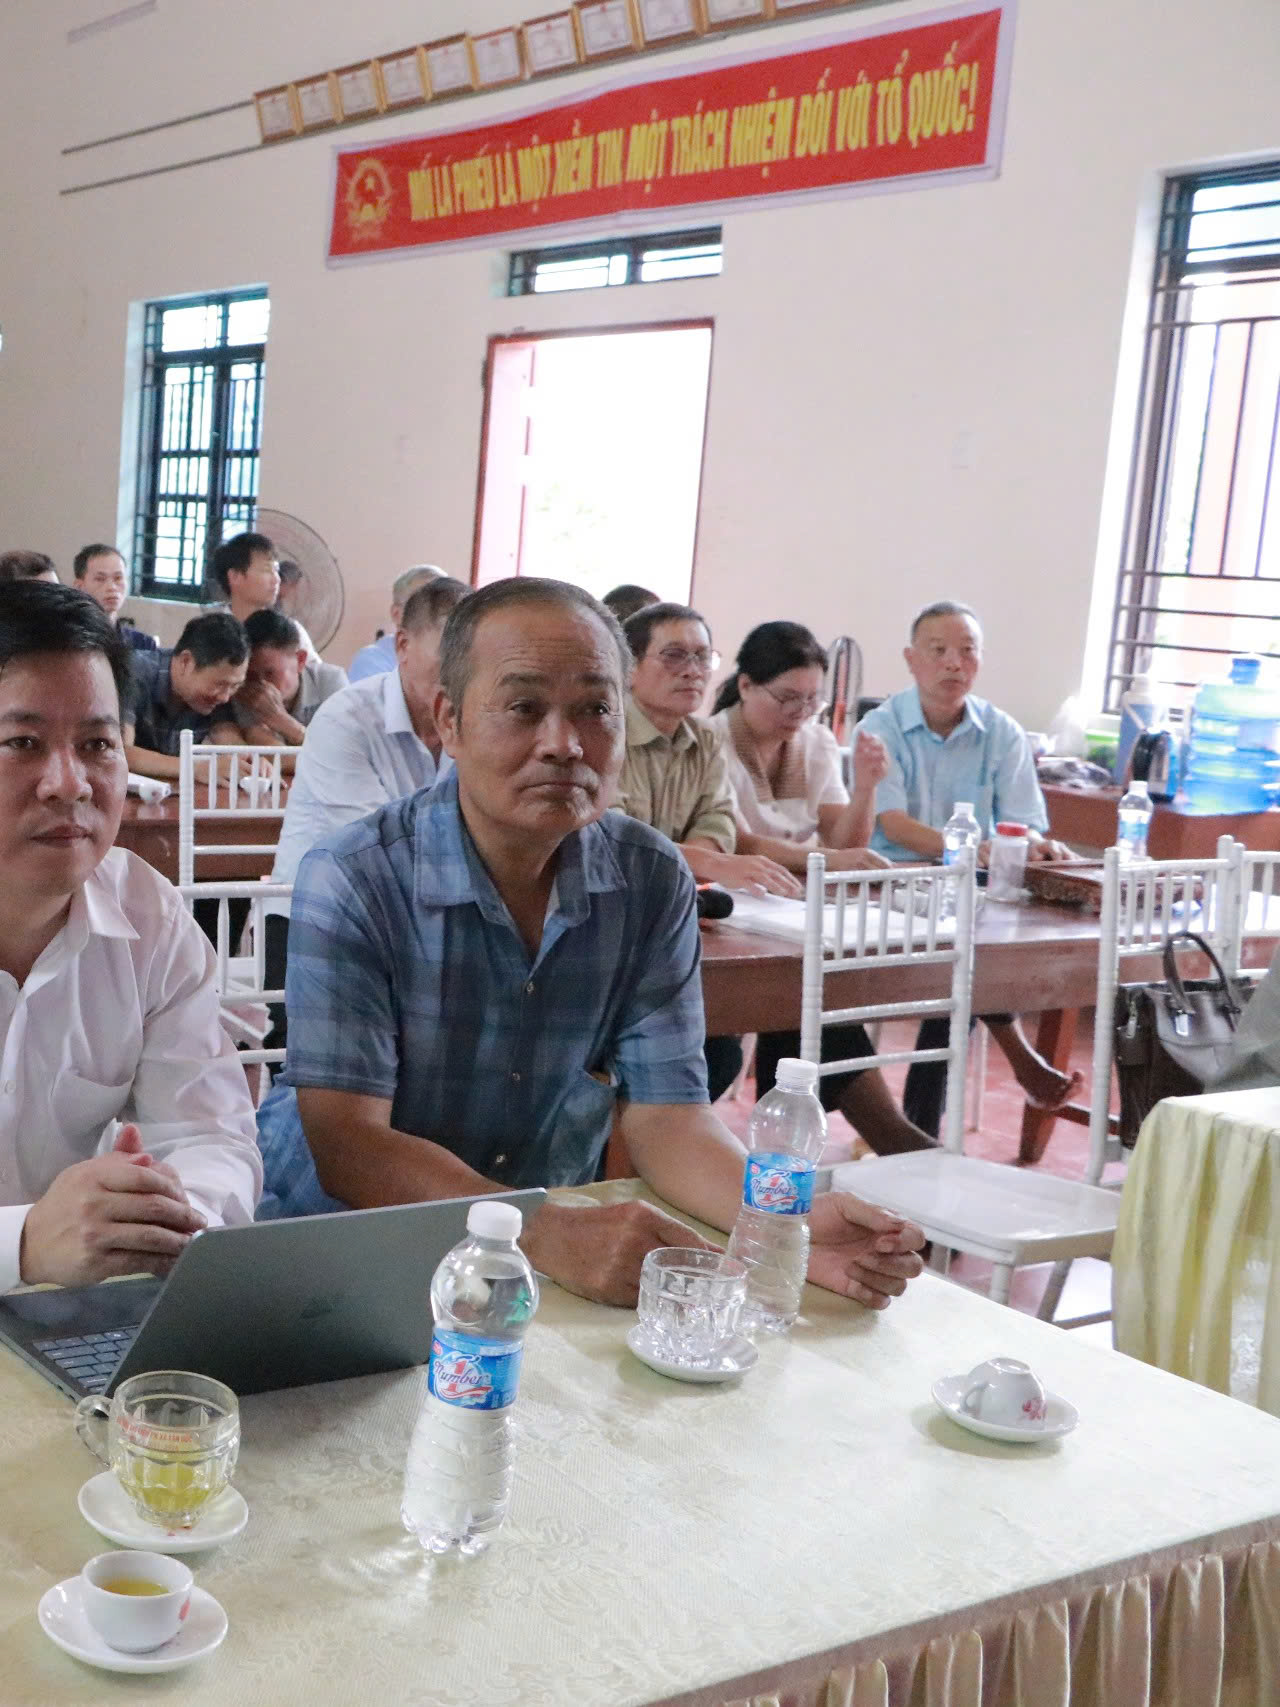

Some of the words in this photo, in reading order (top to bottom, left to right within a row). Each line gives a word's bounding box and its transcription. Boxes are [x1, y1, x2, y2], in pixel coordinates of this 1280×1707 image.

[626, 108, 668, 193] MỘT
[671, 100, 728, 177] TRÁCH
[729, 87, 795, 178] NHIỆM
[795, 68, 834, 158] ĐỐI
[836, 70, 872, 152] VỚI
[877, 49, 908, 147] TỔ
[908, 40, 979, 149] QUỐC!
[434, 1361, 483, 1385] Number
